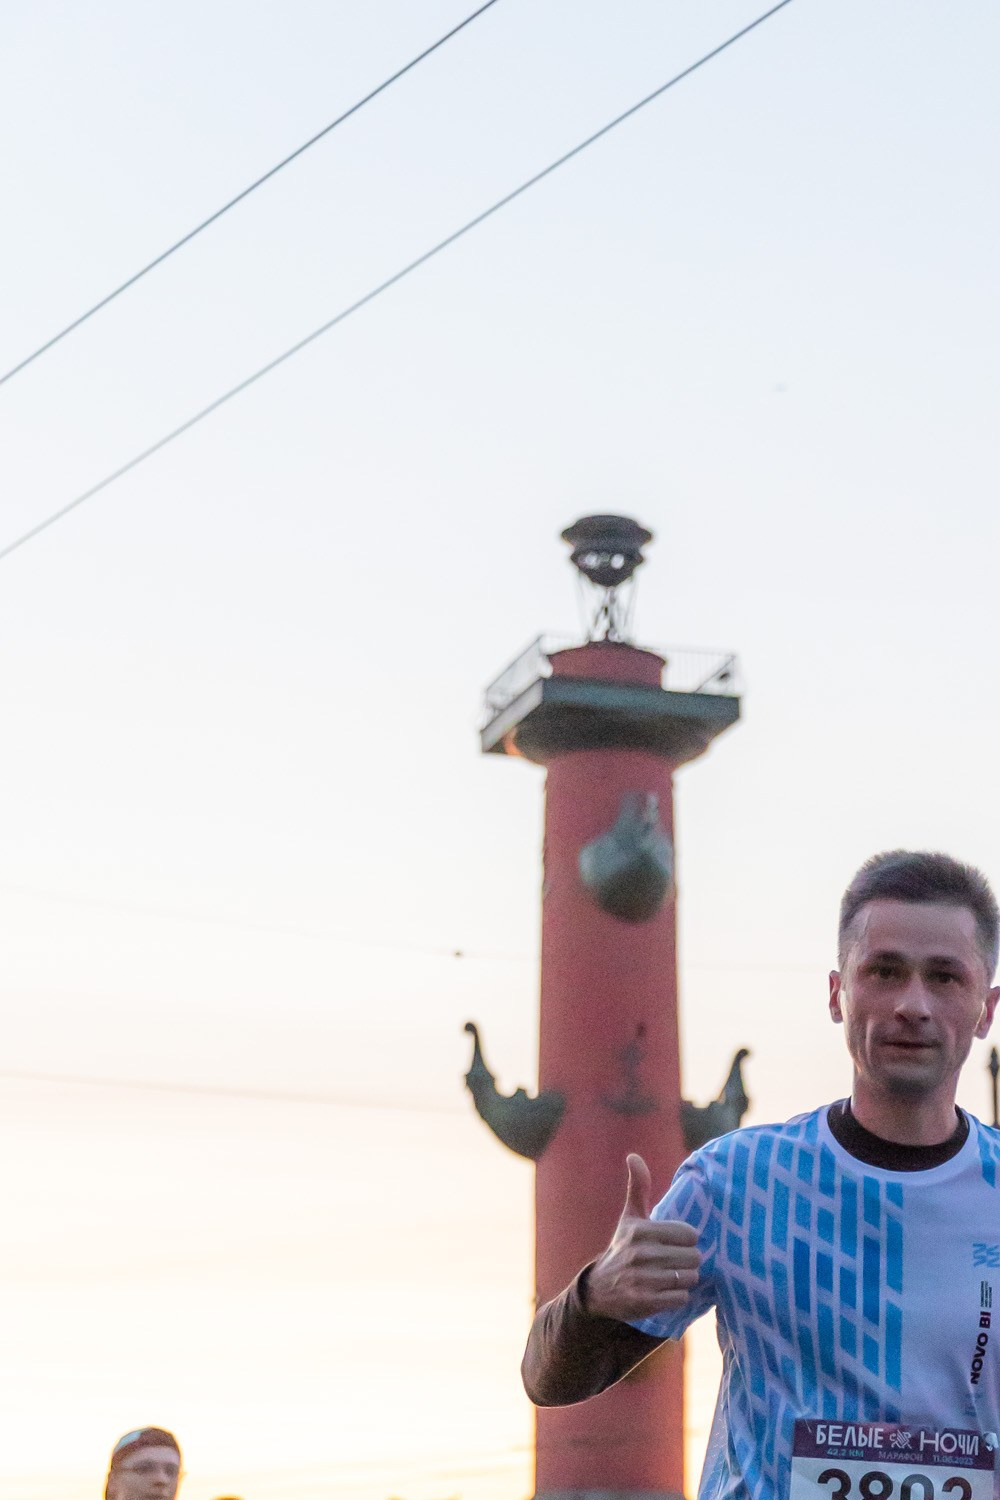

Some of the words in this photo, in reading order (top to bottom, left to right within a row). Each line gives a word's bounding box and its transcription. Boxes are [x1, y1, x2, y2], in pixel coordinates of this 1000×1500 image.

[979, 1311, 991, 1329] BI
[970, 1332, 989, 1385] NOVO
[816, 1424, 884, 1449] БЕЛЫЕ
[919, 1430, 979, 1456] НОЧИ
[878, 1450, 924, 1462] МАРАФОН
